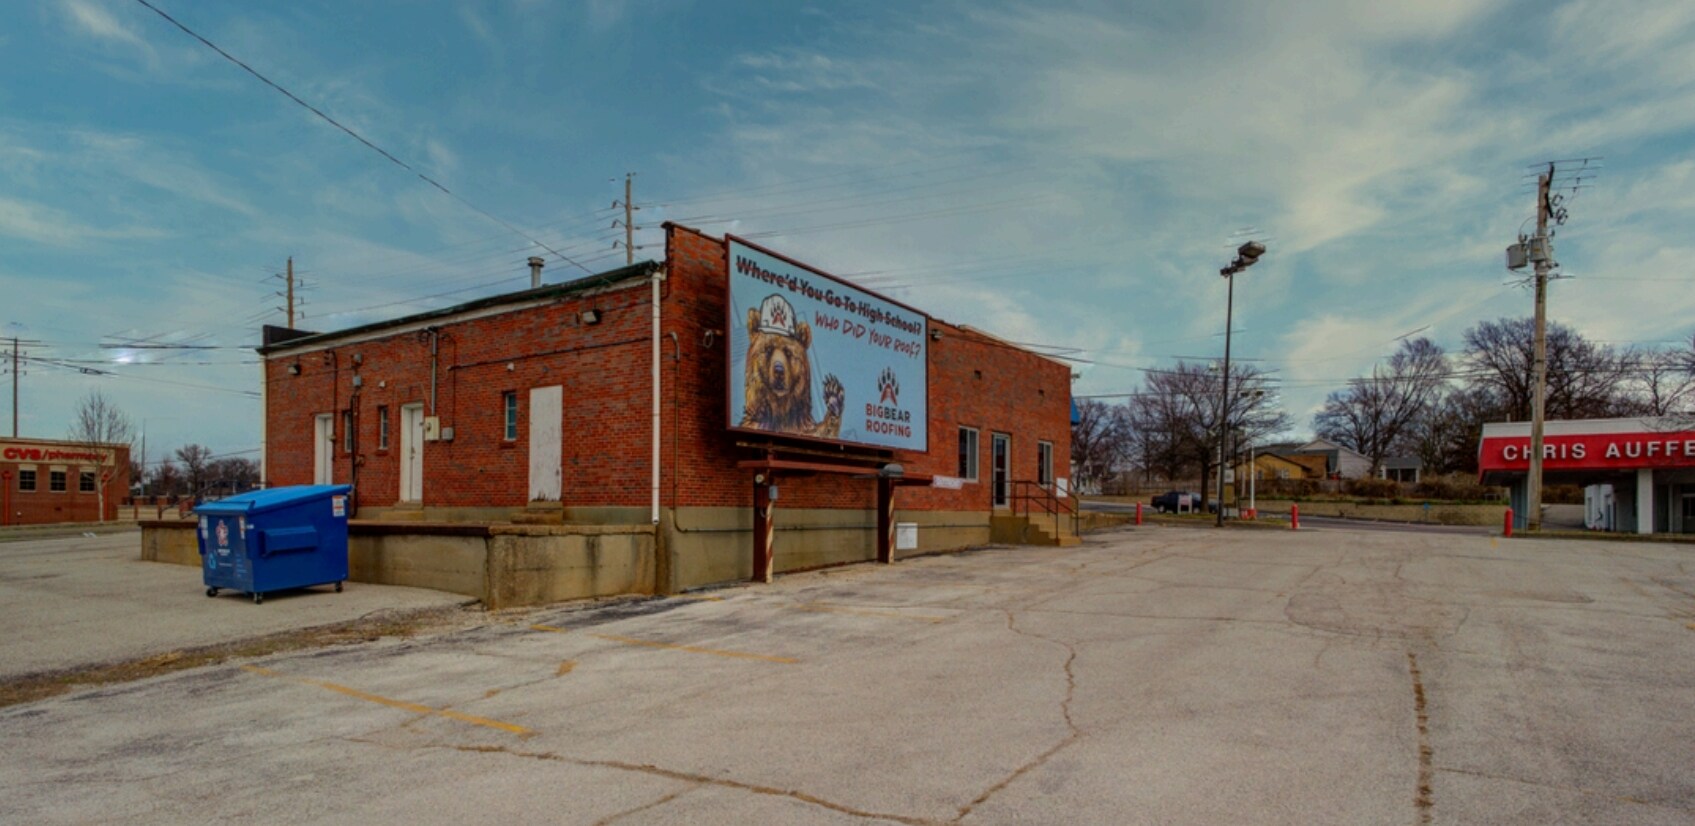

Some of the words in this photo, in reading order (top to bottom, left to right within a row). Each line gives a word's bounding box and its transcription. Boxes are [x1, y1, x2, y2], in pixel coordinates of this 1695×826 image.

[736, 255, 797, 293] Where'd
[800, 279, 823, 301] You
[825, 289, 842, 308] Go
[844, 295, 857, 313] To
[858, 301, 883, 324] High
[885, 311, 922, 336] School?
[815, 311, 839, 331] WHO
[869, 328, 893, 349] YOUR
[866, 419, 911, 438] ROOFING
